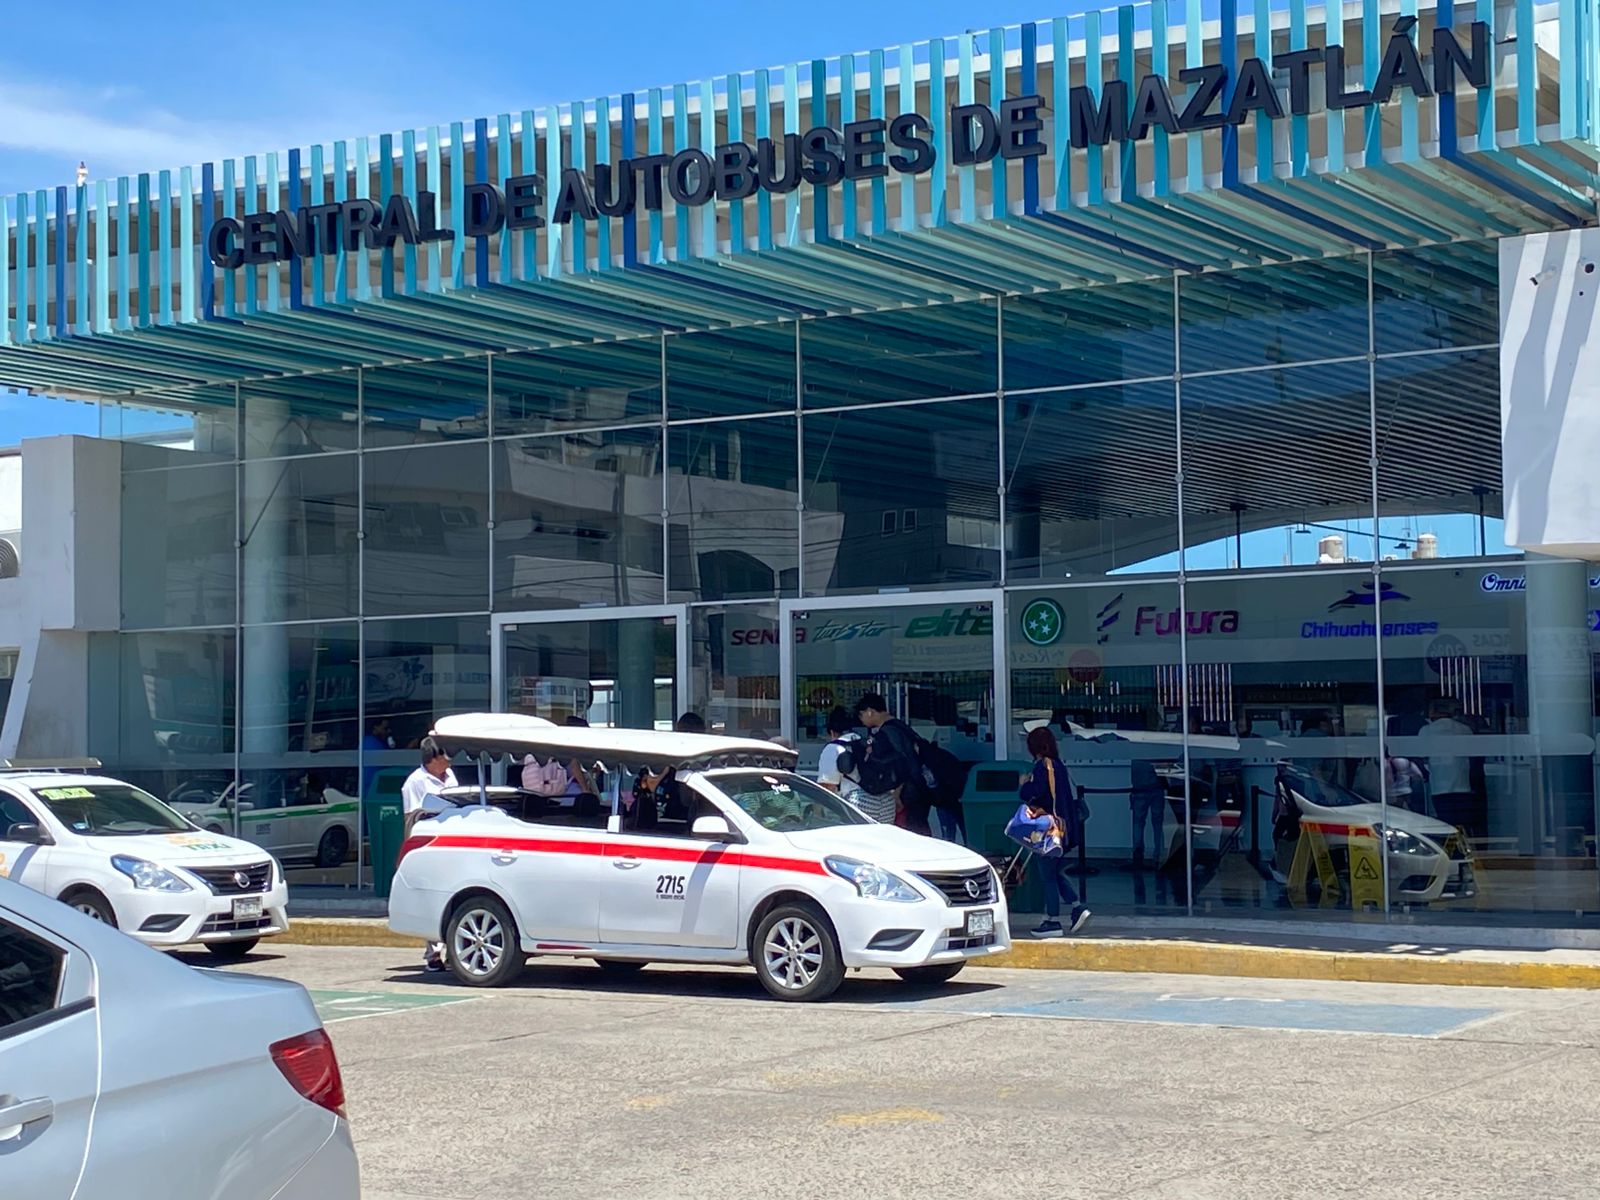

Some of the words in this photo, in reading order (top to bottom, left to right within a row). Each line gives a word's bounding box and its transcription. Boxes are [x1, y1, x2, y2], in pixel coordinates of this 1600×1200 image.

[208, 191, 454, 269] CENTRAL
[464, 174, 545, 237] DE
[552, 113, 935, 223] AUTOBUSES
[951, 95, 1047, 166] DE
[1070, 16, 1490, 148] MAZATLÁN
[1135, 606, 1239, 636] Futura
[656, 875, 685, 894] 2715
